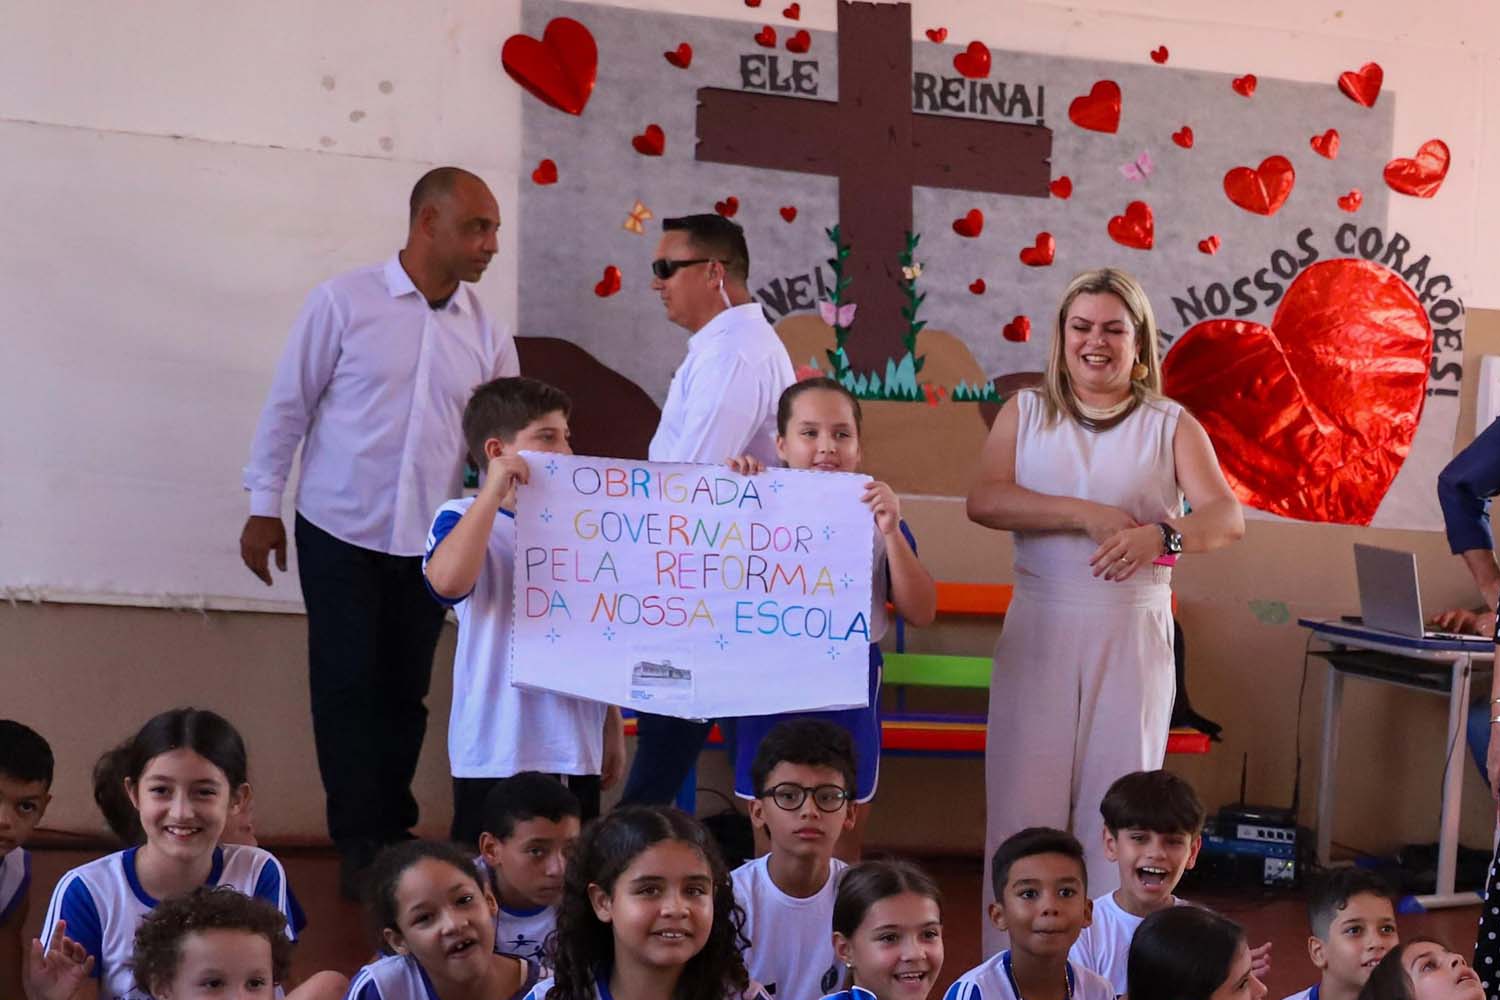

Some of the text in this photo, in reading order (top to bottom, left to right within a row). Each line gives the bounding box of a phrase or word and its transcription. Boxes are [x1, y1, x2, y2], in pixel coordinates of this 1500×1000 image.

[740, 54, 1046, 126] ELE REINA!
[1171, 223, 1465, 397] NOSSOS CORAÇÕES!
[572, 467, 763, 509] OBRIGADA
[574, 509, 814, 554] GOVERNADOR
[525, 547, 835, 597] PELA REFORMA
[525, 587, 871, 641] DA NOSSA ESCOLA
